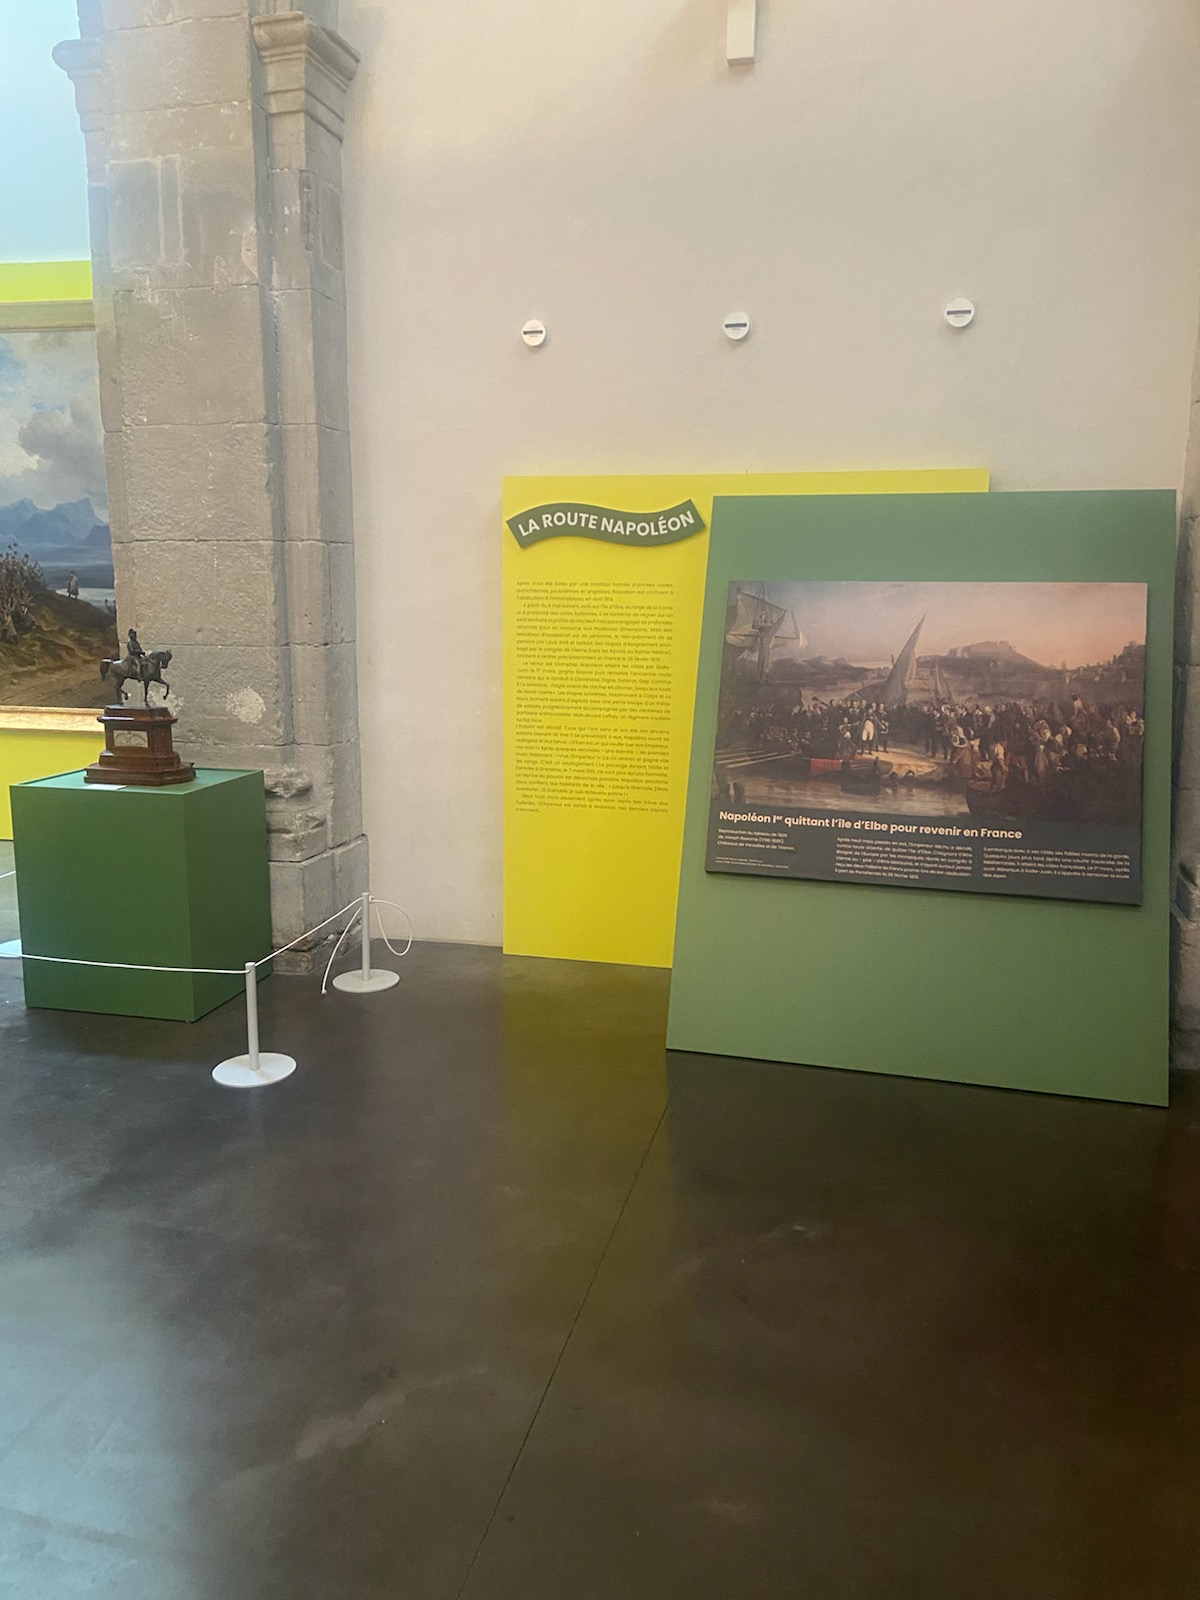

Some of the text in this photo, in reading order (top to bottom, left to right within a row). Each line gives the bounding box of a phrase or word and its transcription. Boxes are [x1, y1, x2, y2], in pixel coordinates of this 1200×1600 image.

[518, 510, 695, 537] LA ROUTE NAPOLÉON
[719, 811, 771, 823] Napoléon
[784, 816, 830, 828] quittant
[831, 819, 852, 829] l'île
[854, 820, 888, 831] d'Elbe
[890, 822, 917, 834] pour
[919, 826, 962, 836] revenir
[963, 829, 978, 837] en
[980, 828, 1023, 839] France
